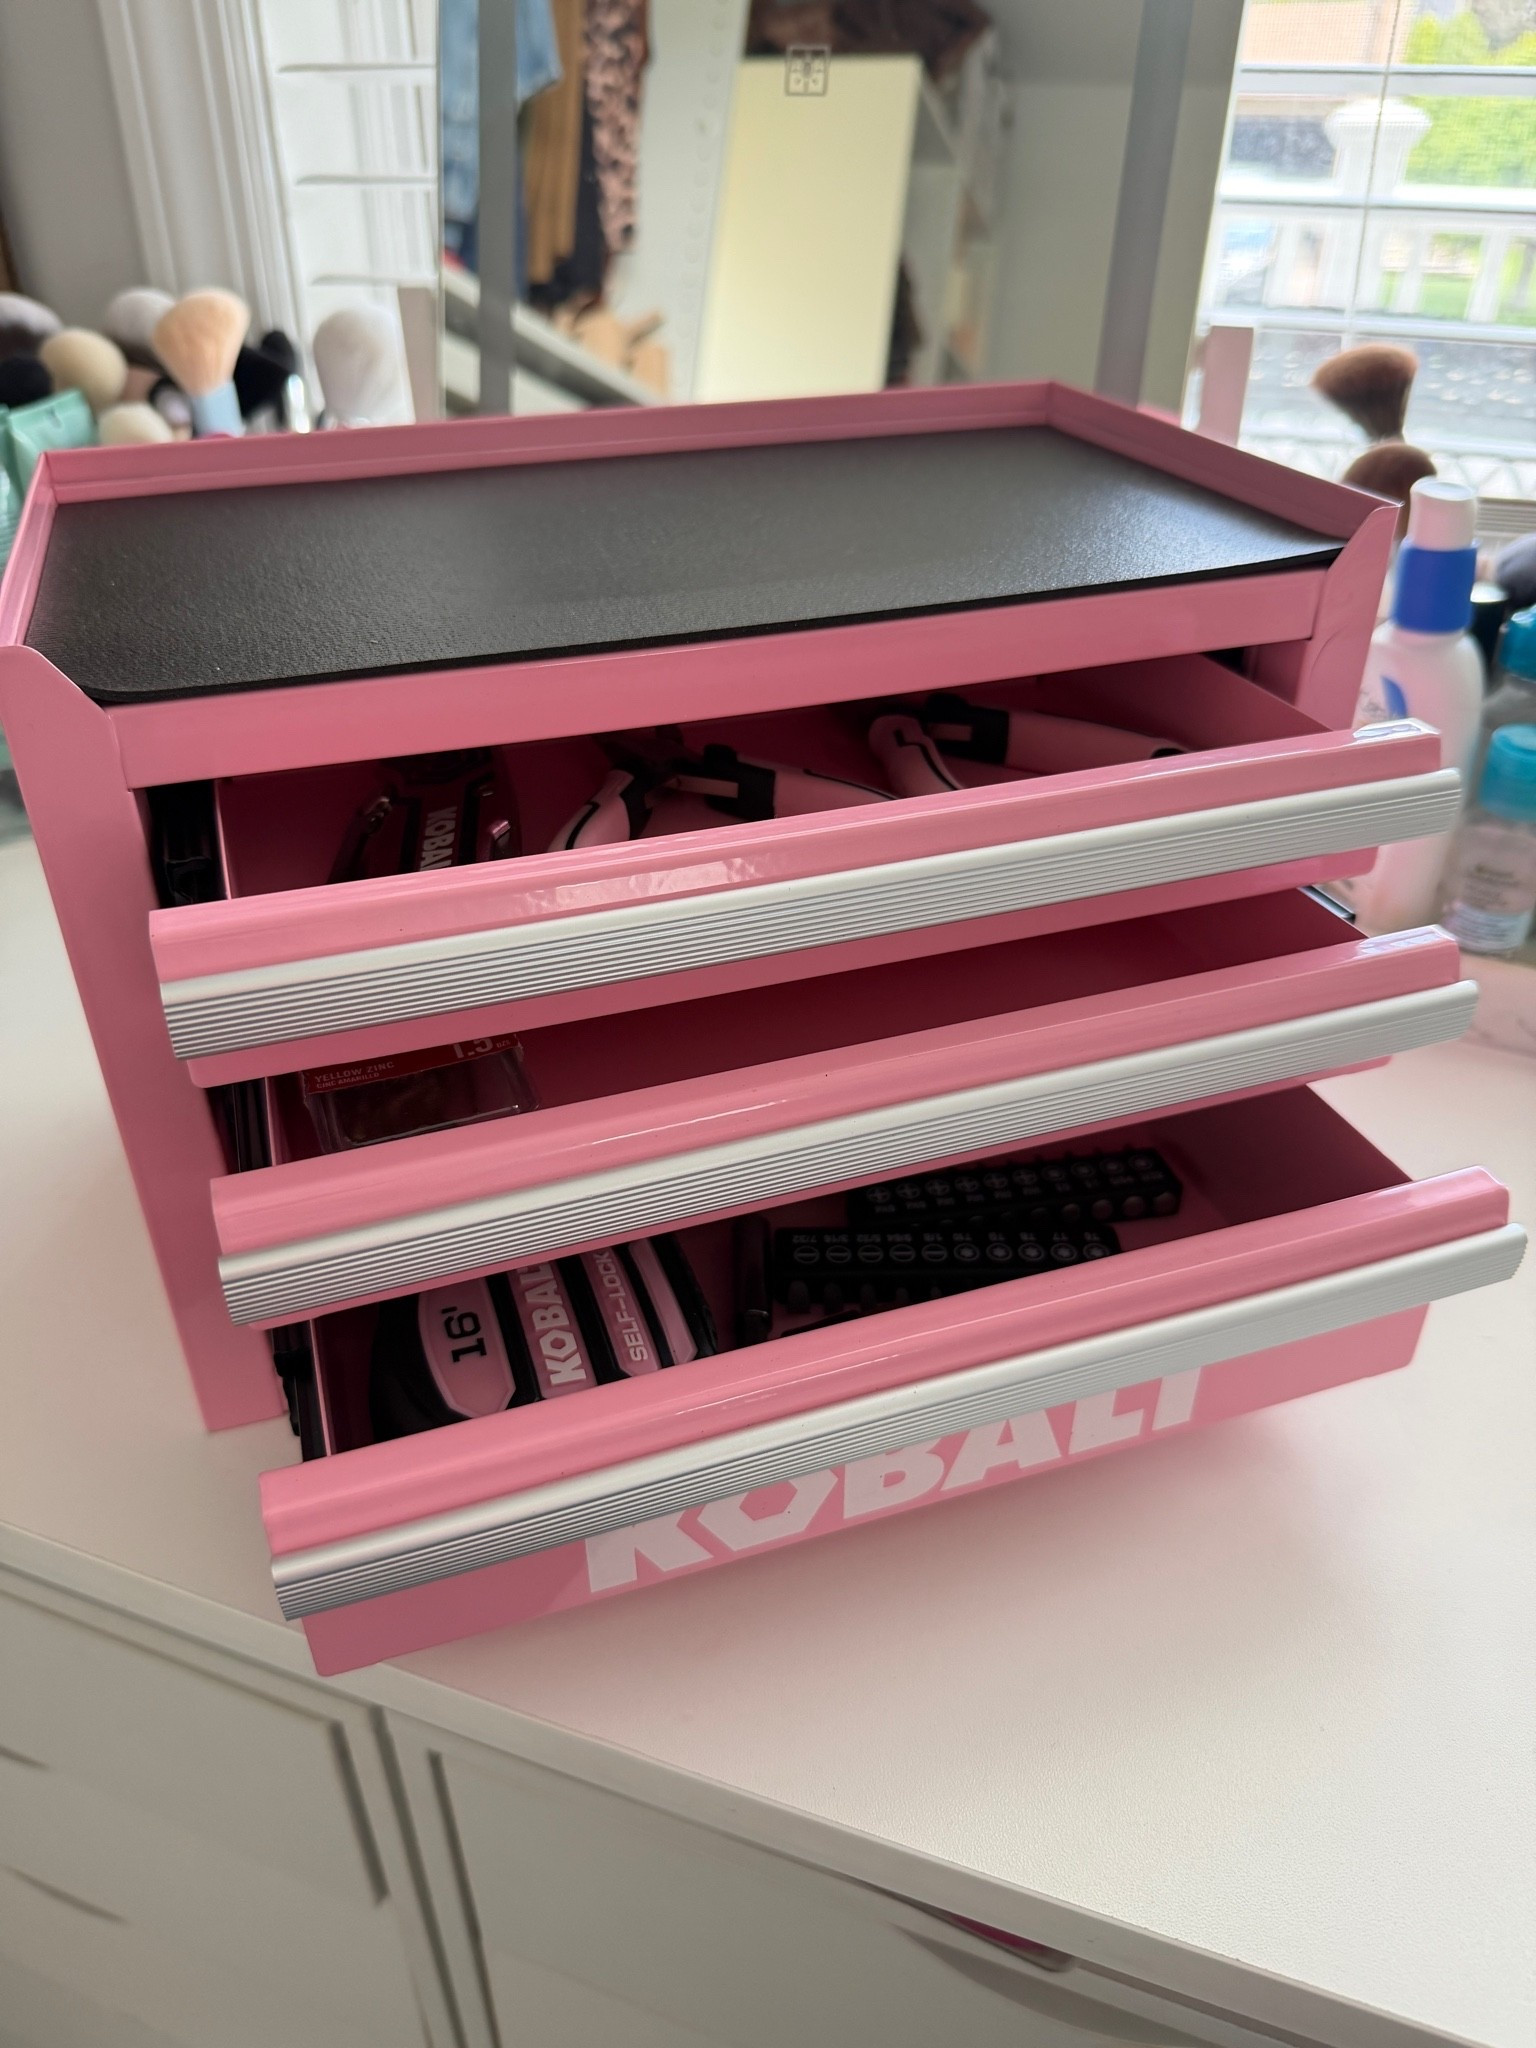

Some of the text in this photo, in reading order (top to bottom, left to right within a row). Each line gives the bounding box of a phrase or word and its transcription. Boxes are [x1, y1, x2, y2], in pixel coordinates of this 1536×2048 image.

[315, 1061, 395, 1083] YELLOW ZINC
[338, 1072, 380, 1084] AMARILLO
[517, 1263, 586, 1386] KOBAL
[593, 1250, 648, 1361] SELF-LOCK
